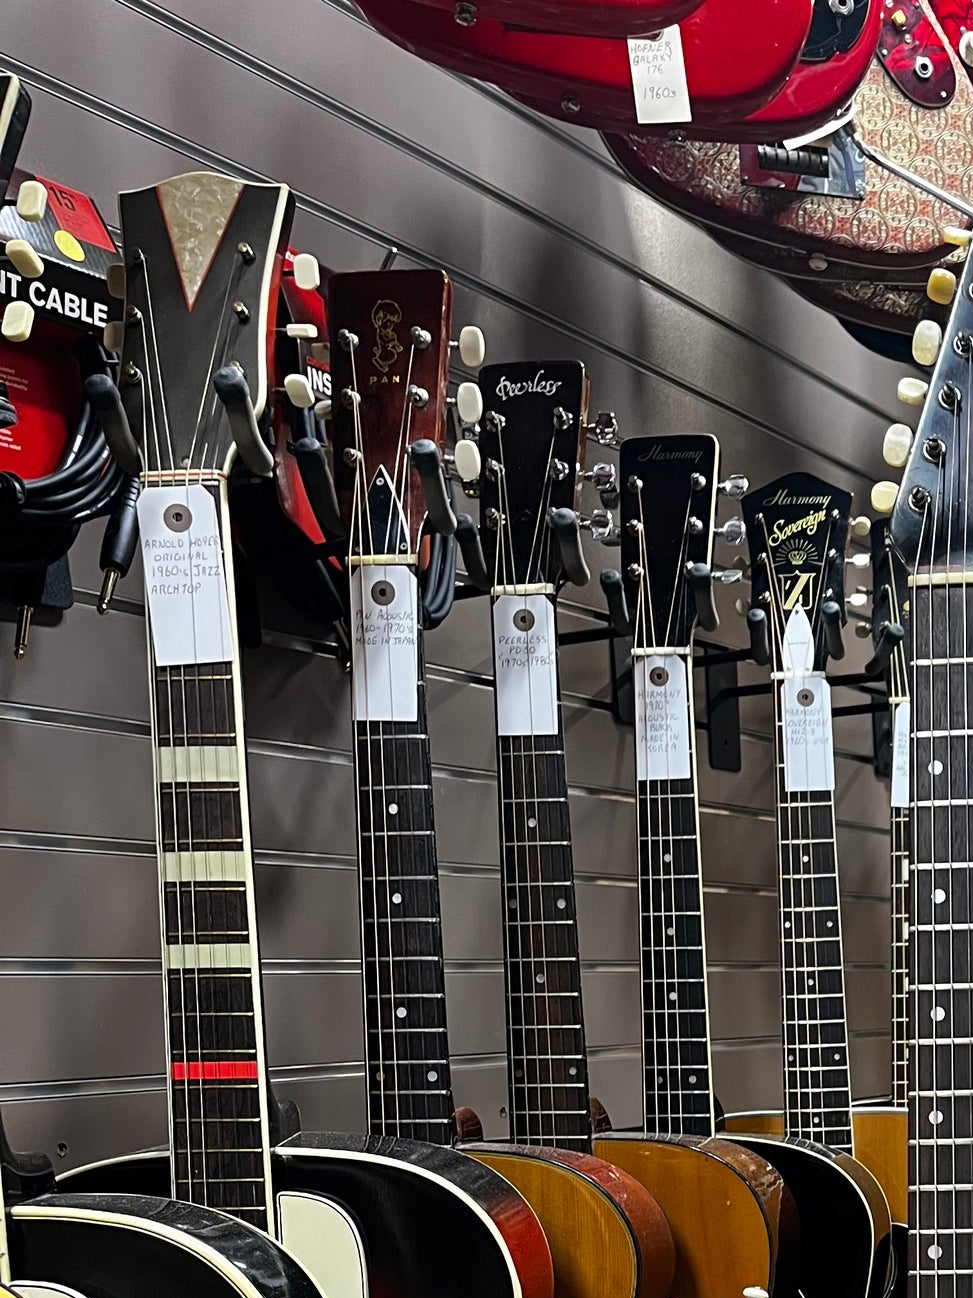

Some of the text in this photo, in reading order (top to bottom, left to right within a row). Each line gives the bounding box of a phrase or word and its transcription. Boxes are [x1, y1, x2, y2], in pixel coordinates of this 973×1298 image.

[631, 41, 672, 54] HOFNER
[648, 64, 663, 74] 176
[29, 281, 108, 328] CABLE
[370, 376, 400, 385] PAN
[496, 370, 562, 401] Peerless
[638, 444, 703, 464] Harmony
[763, 489, 832, 509] Harmony
[768, 509, 827, 546] Sovereign
[144, 538, 184, 549] ARNOLD
[154, 551, 207, 562] ORIGINAL
[193, 563, 221, 577] JAZZ
[498, 634, 547, 644] PEERLESS
